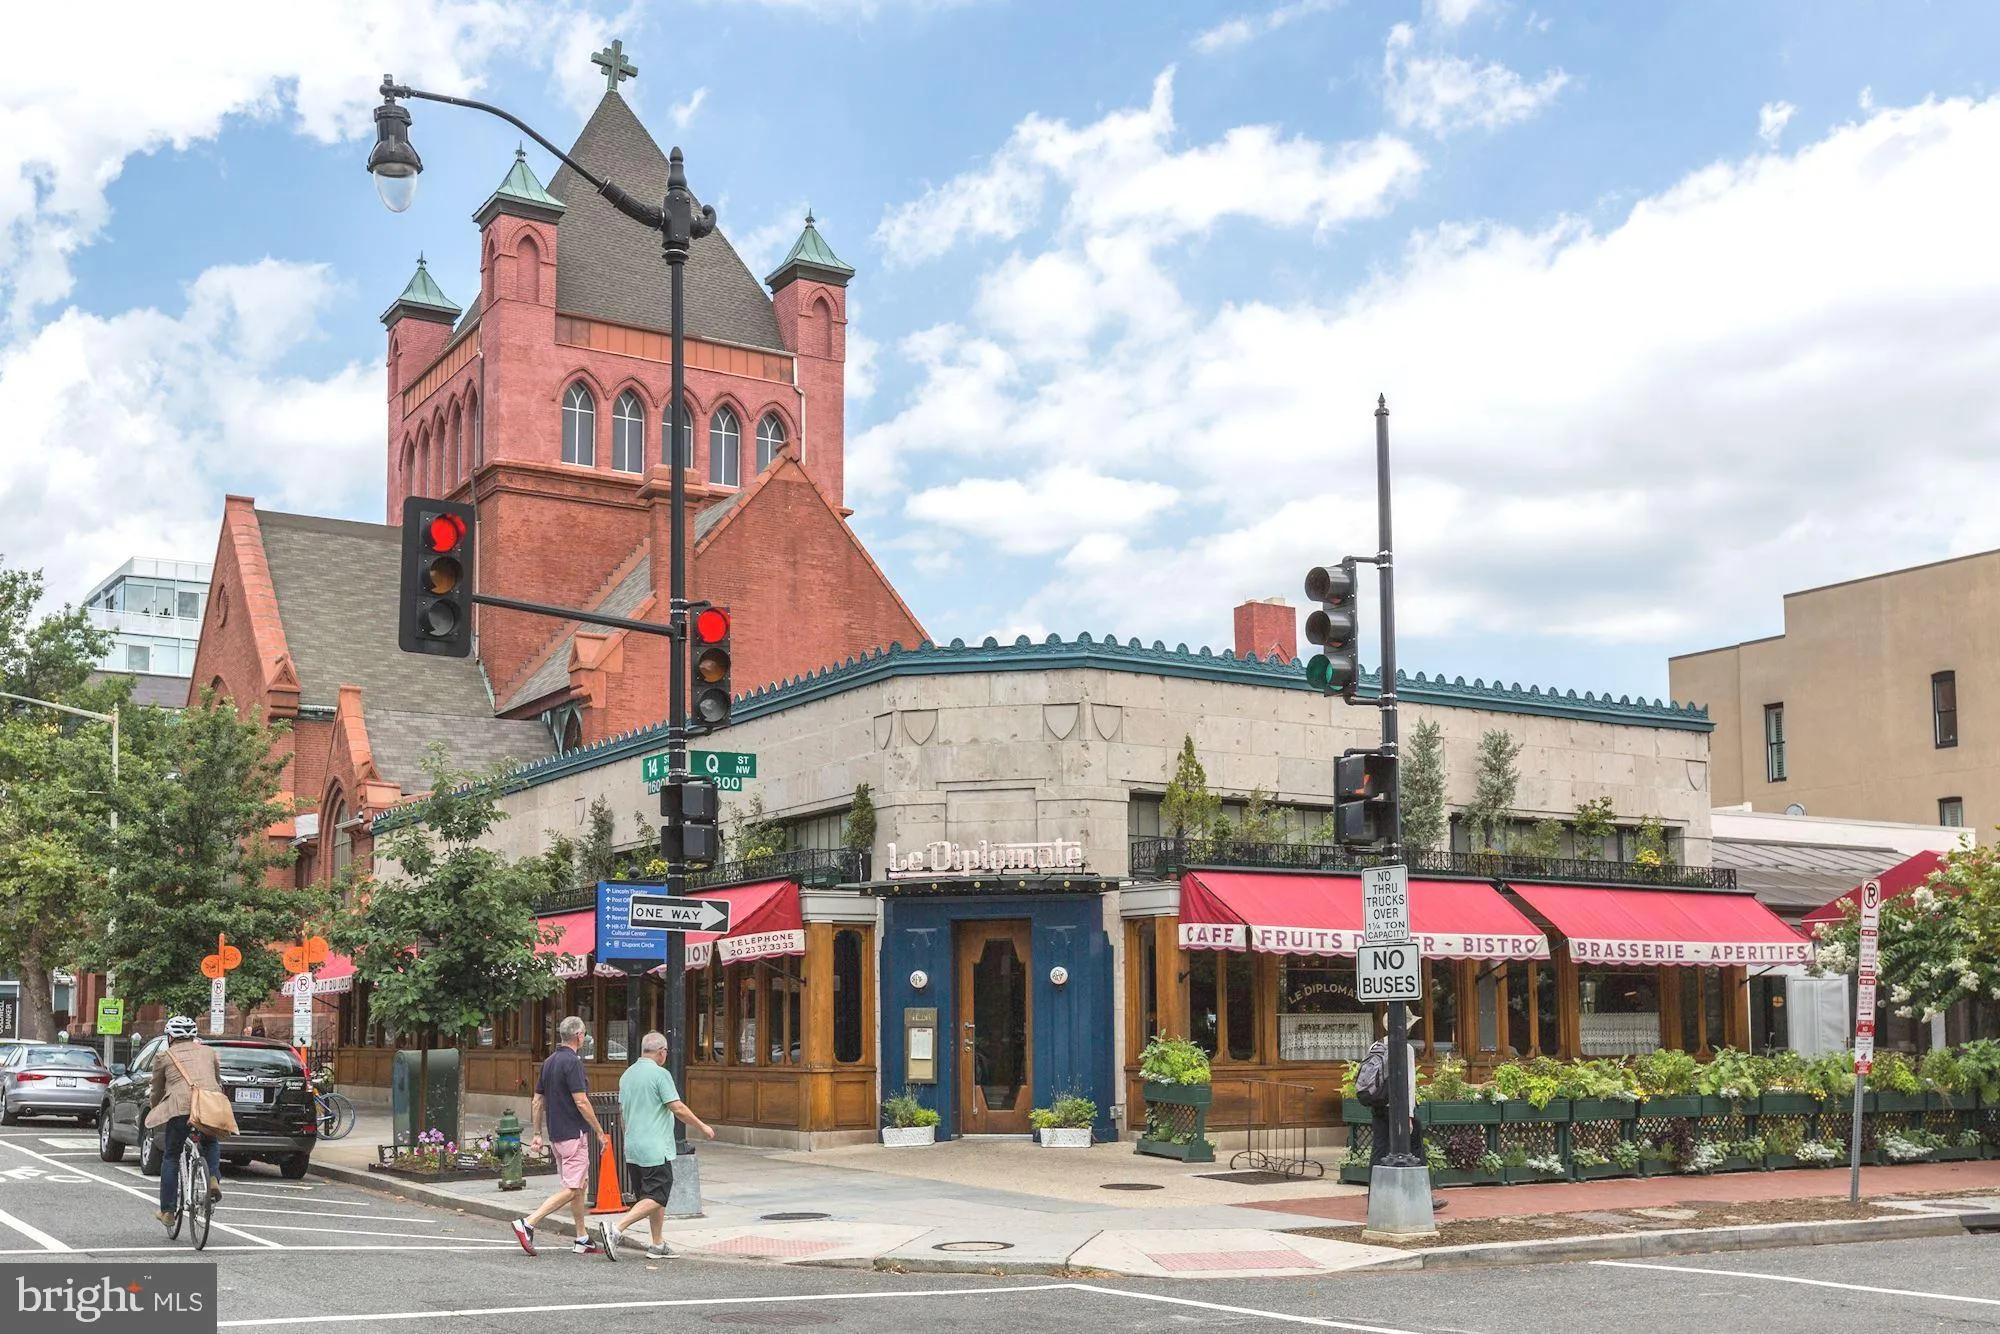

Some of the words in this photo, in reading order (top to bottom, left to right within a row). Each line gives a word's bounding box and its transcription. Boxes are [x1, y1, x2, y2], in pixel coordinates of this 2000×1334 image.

[647, 758, 658, 778] 14
[705, 754, 719, 774] Q
[737, 755, 749, 765] ST
[735, 766, 751, 774] NW
[886, 842, 924, 872] Le
[927, 837, 1082, 877] Diplomate
[1377, 870, 1391, 882] NO
[1372, 883, 1398, 895] THRU
[1366, 894, 1405, 908] TRUCKS
[635, 907, 664, 919] ONE
[671, 909, 701, 920] WAY
[1373, 907, 1399, 920] OVER
[1385, 921, 1405, 930] TON
[730, 933, 794, 948] TELEPHONE
[1187, 926, 1234, 943] CAFE
[1260, 929, 1343, 949] FRUITS
[1463, 937, 1538, 953] BISTRO
[1368, 930, 1405, 940] CAPACITY
[1577, 941, 1684, 959] BRASSERIE
[1373, 949, 1405, 970] NO
[1362, 975, 1416, 994] BUSES
[1288, 991, 1303, 1004] LE
